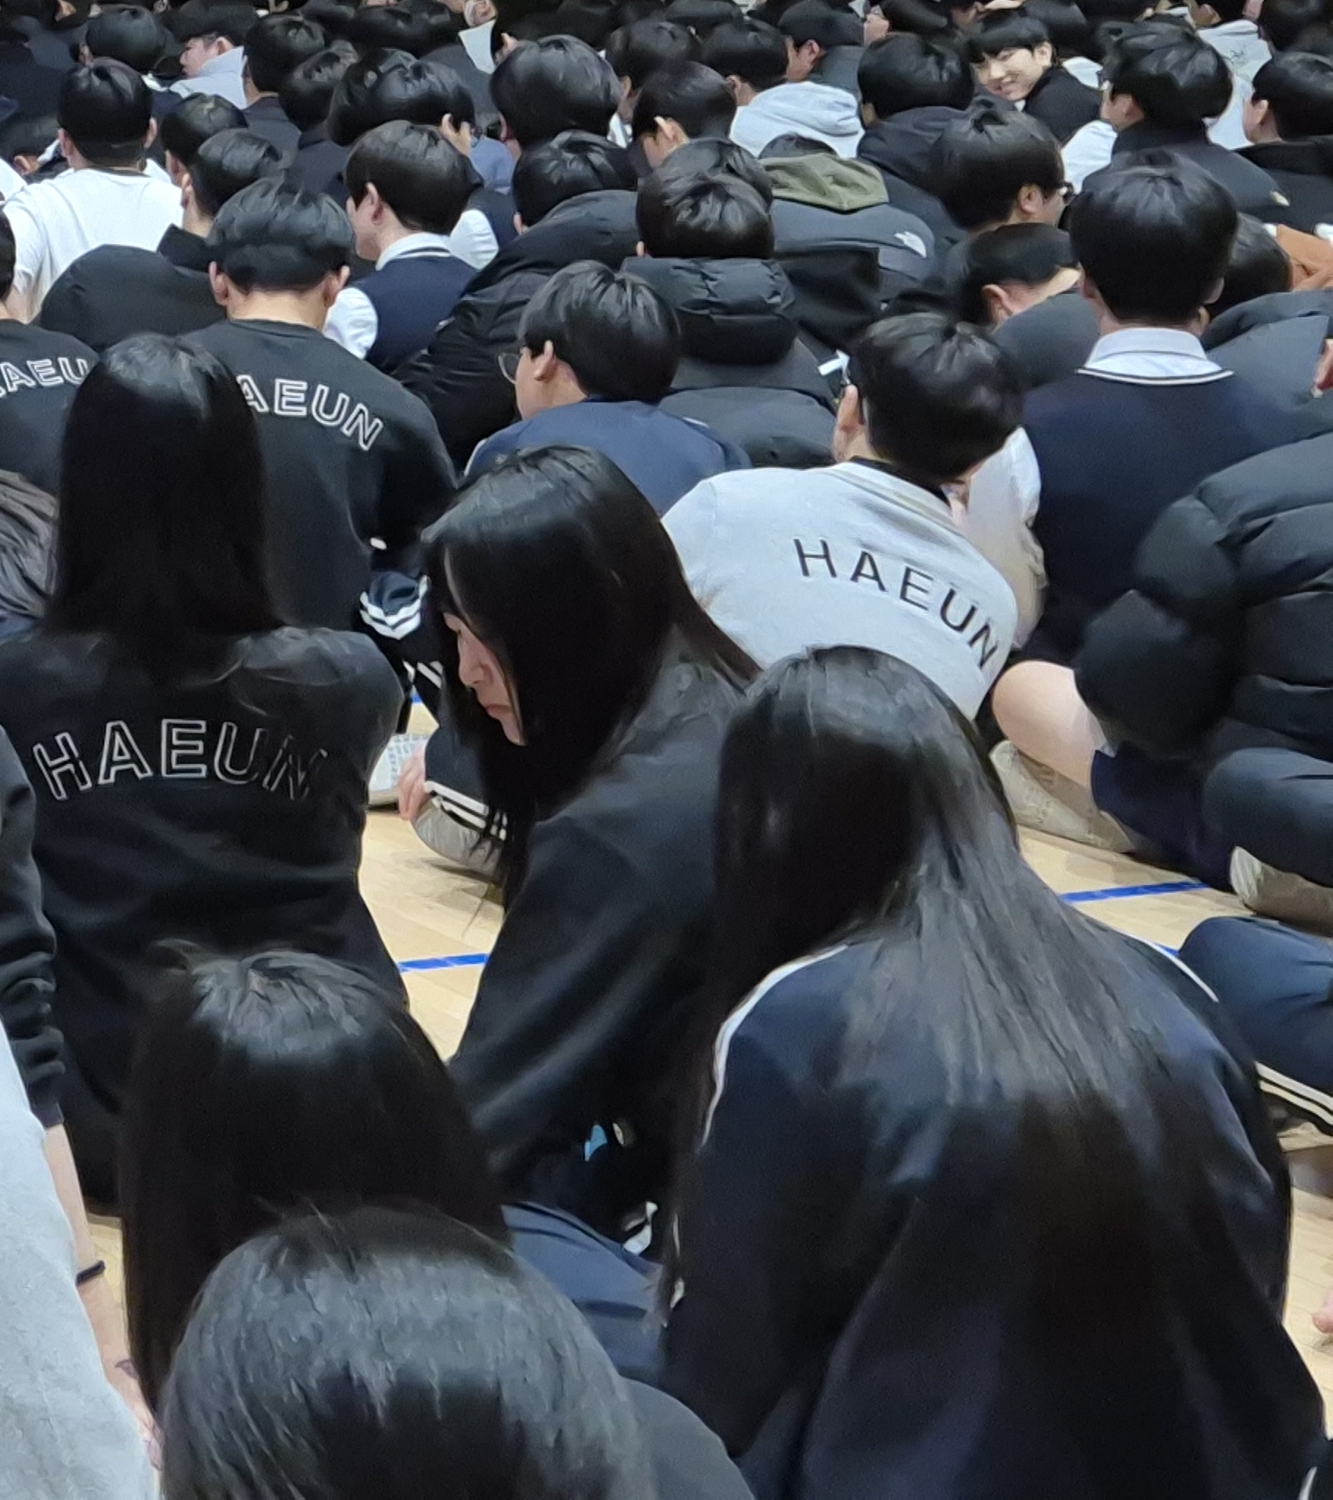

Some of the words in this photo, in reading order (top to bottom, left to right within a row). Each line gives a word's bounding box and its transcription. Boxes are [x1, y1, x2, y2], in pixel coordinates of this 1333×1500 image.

[235, 373, 384, 452] AEUN
[793, 537, 1001, 671] HAEUN
[32, 718, 329, 801] HAEUN
